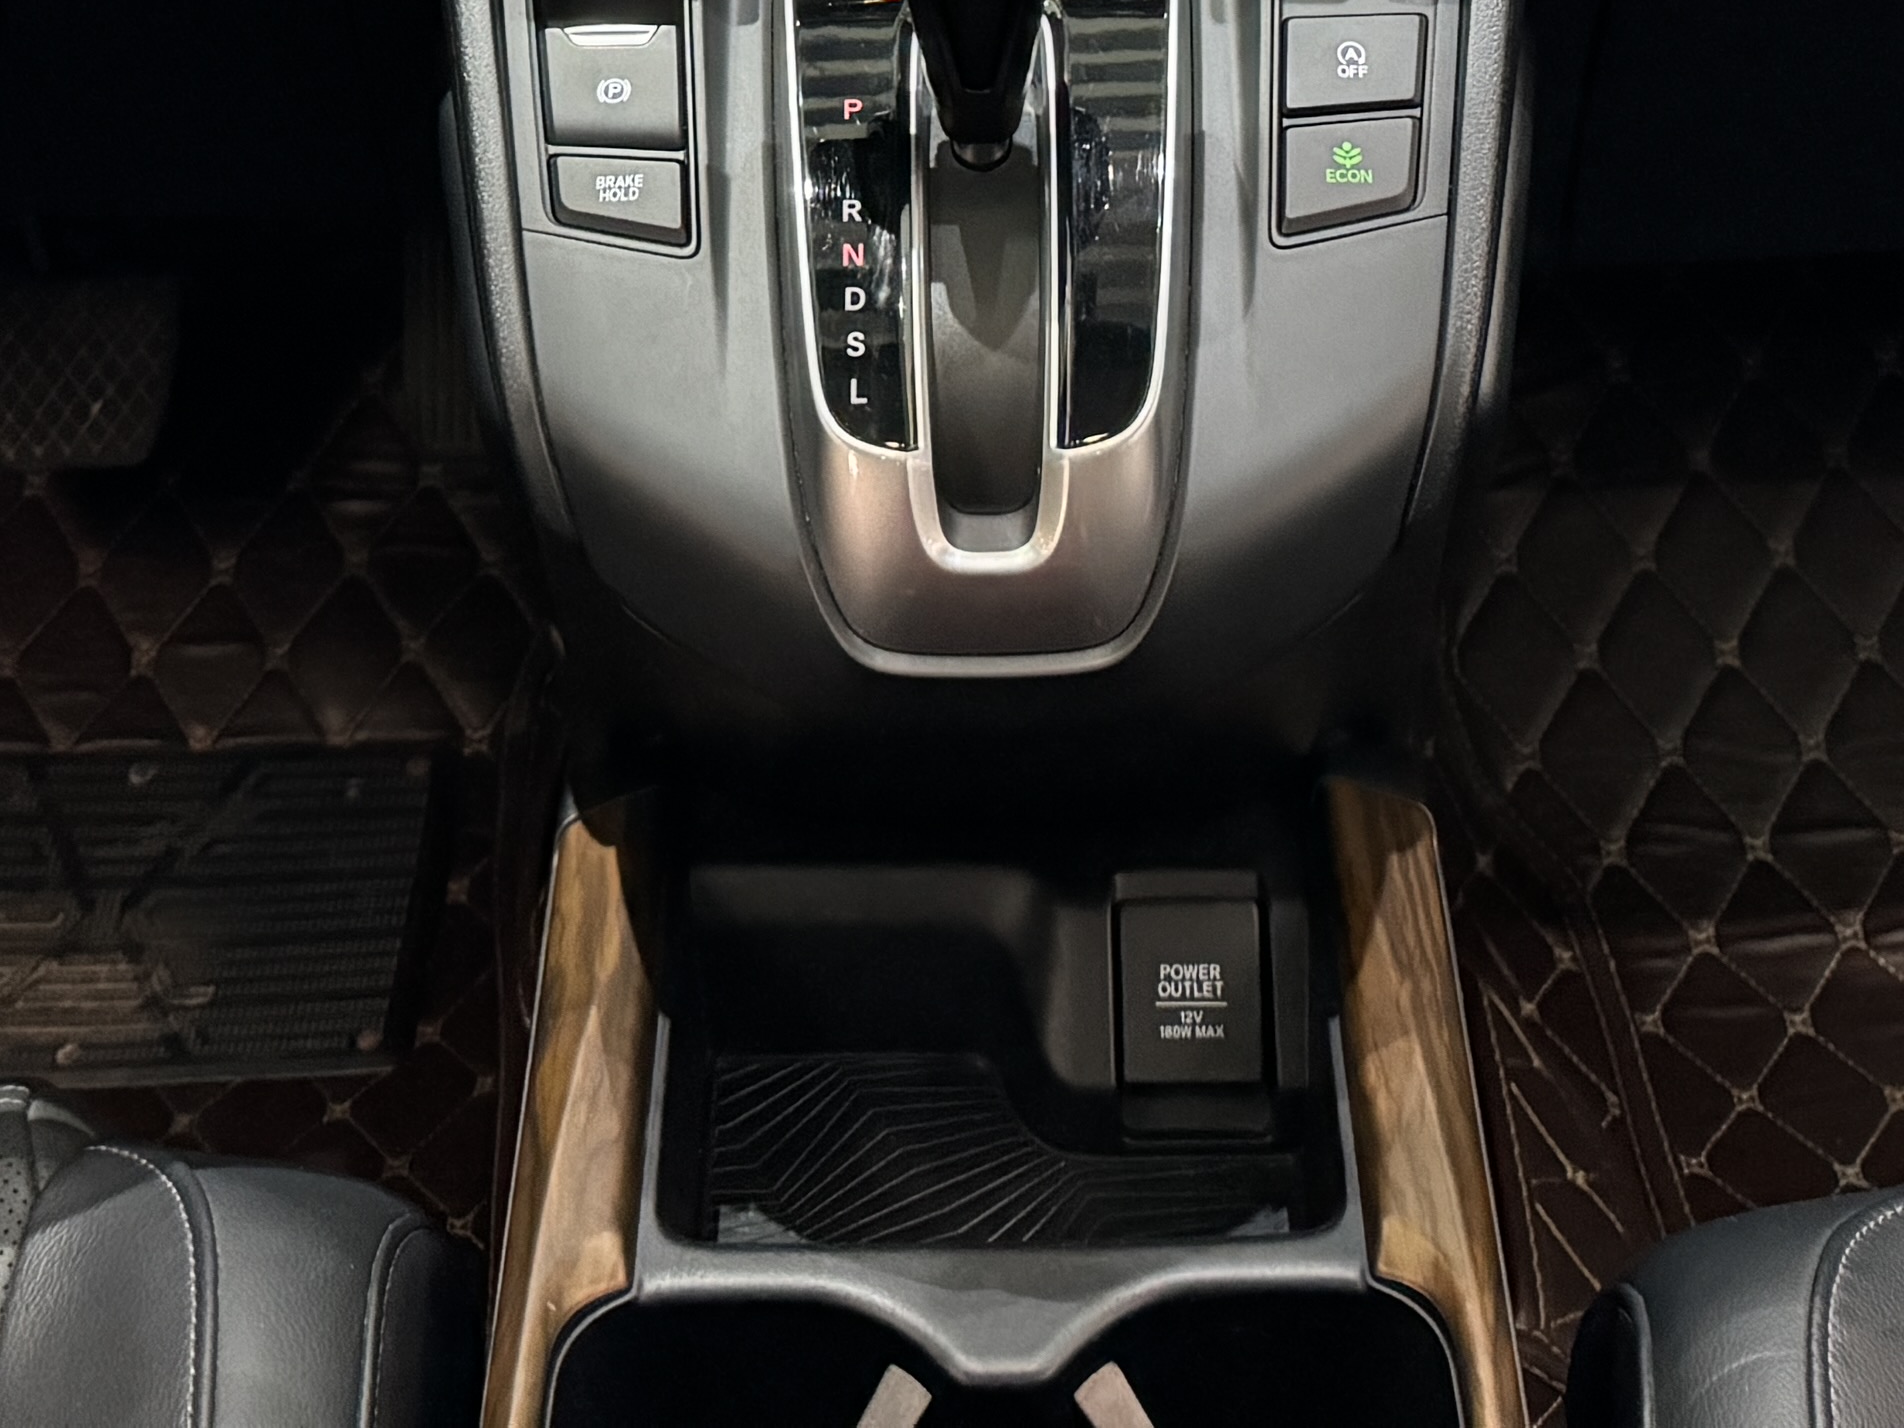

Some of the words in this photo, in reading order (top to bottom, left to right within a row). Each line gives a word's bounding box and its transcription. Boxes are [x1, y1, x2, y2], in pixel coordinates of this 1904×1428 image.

[1336, 64, 1369, 79] OFF
[843, 98, 864, 120] P
[595, 174, 644, 190] BRAKE
[1325, 168, 1374, 184] ECON
[598, 188, 640, 202] HOLD
[841, 199, 863, 222] R
[842, 243, 865, 267] N
[844, 286, 866, 312] D
[846, 330, 866, 358] S
[849, 378, 868, 404] L
[1159, 963, 1221, 980] POWER
[1157, 980, 1224, 998] OUTLET
[1180, 1010, 1204, 1024] 12V
[1195, 1024, 1225, 1039] MAX
